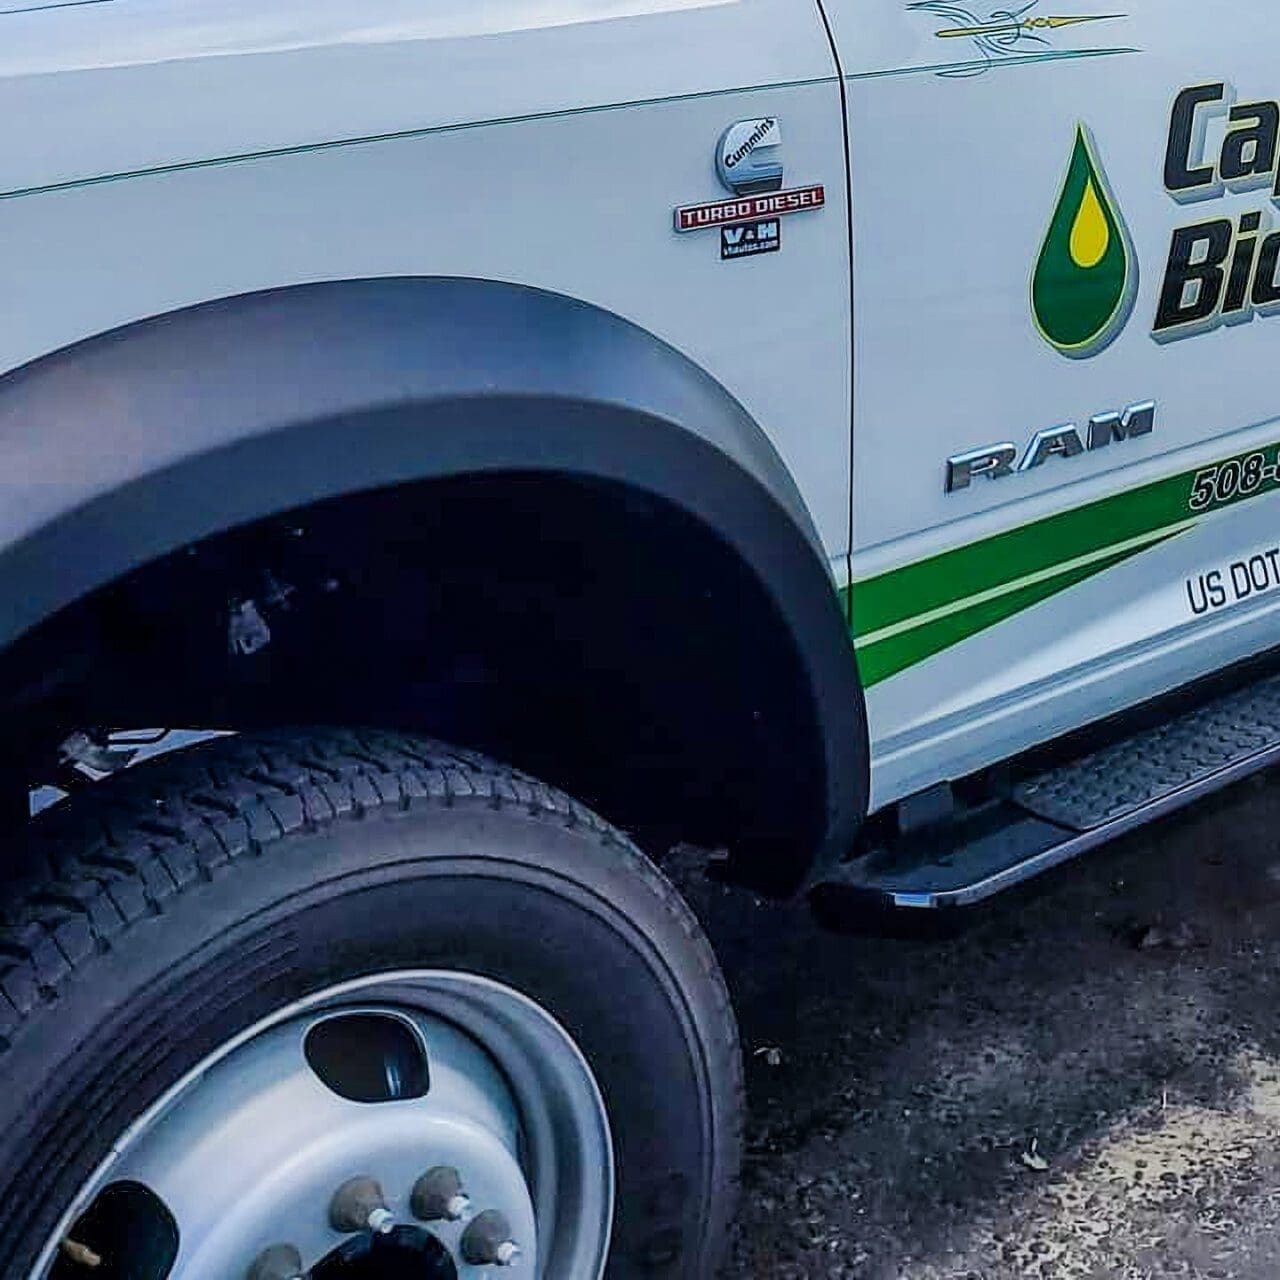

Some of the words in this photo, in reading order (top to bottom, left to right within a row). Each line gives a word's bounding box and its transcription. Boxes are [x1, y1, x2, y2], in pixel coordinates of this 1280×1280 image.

[724, 119, 775, 169] Cummins
[682, 204, 750, 225] TURBO
[755, 190, 824, 213] DIESEL
[944, 399, 1157, 494] RAM
[1185, 574, 1227, 616] US
[1230, 553, 1280, 601] DOT
